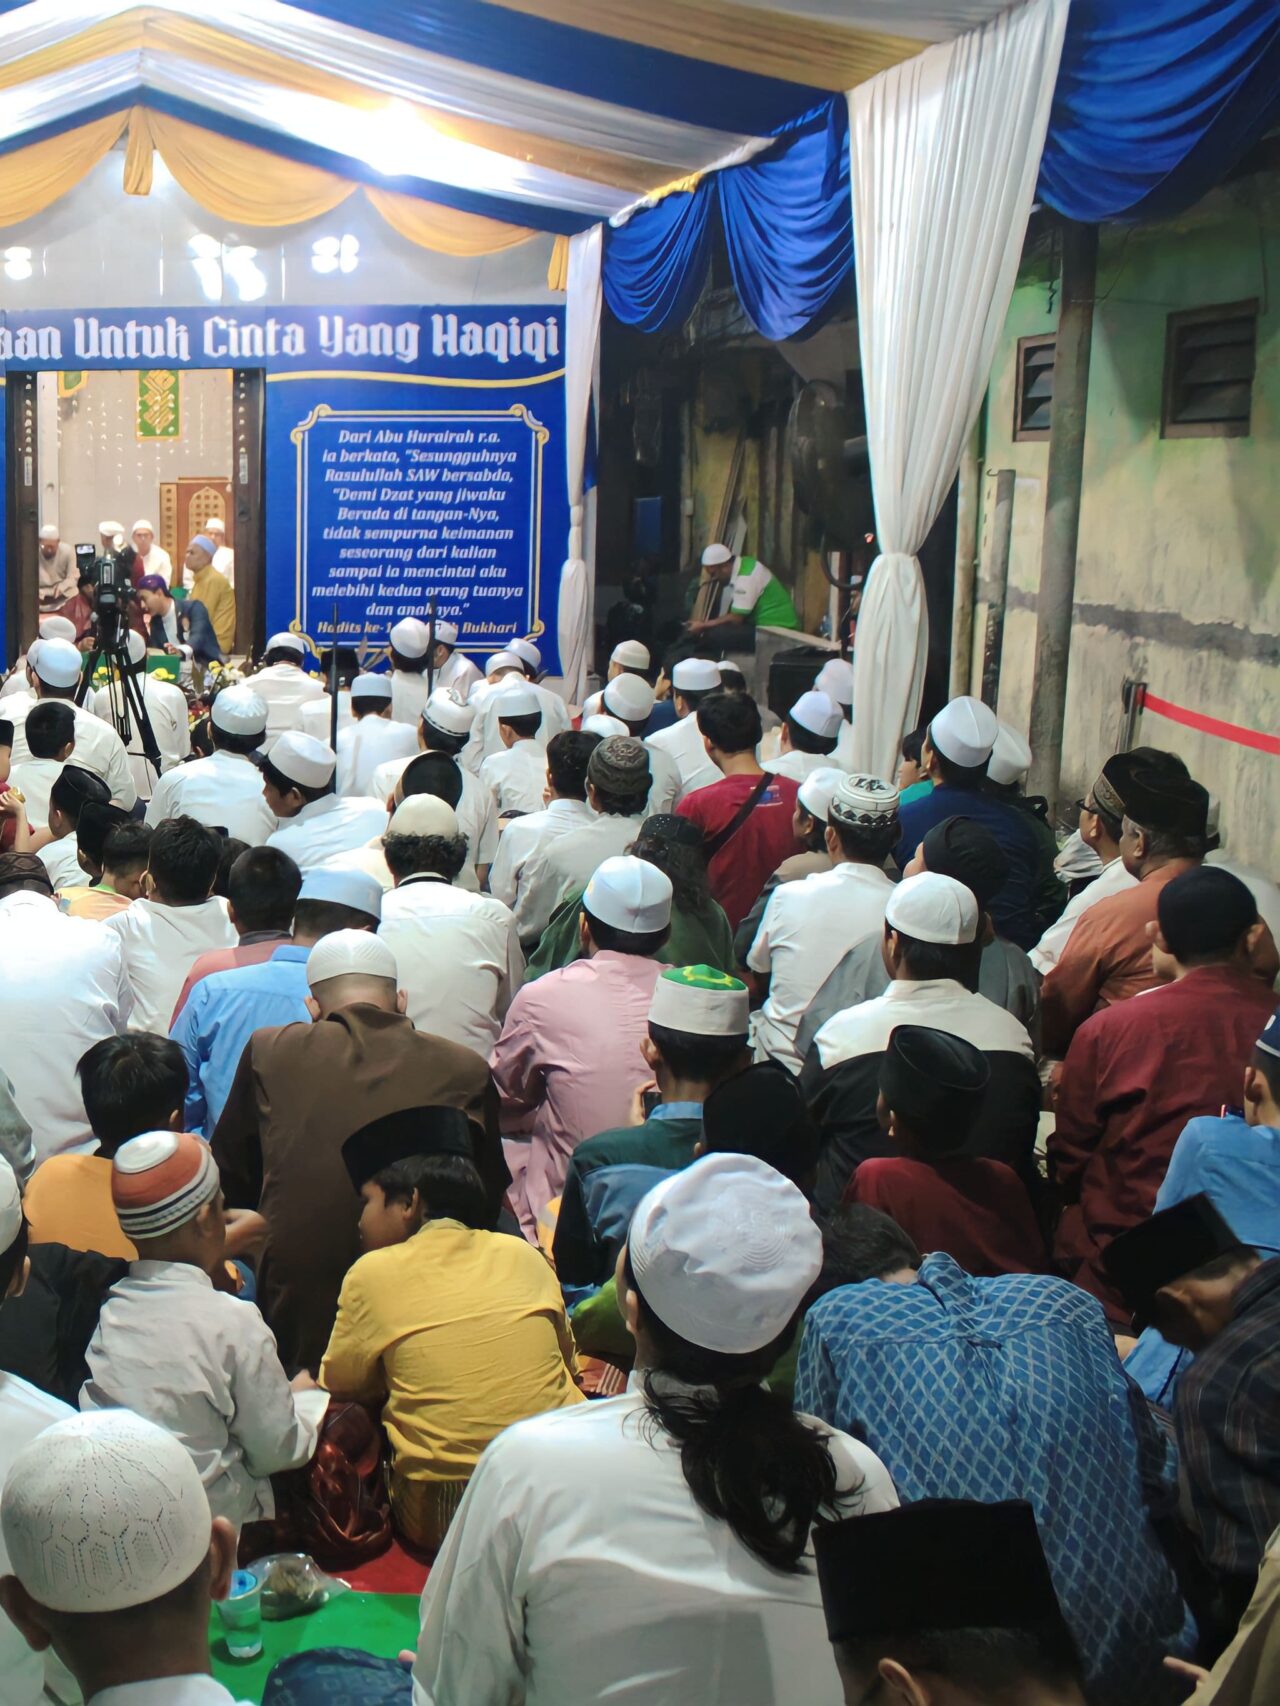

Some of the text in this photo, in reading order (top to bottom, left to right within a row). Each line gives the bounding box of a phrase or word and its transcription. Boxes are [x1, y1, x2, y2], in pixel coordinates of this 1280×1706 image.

[74, 316, 191, 362] Untuk
[203, 315, 306, 357] Cinta
[318, 315, 420, 364] Yang
[431, 313, 560, 364] Haqiqi
[338, 430, 501, 443] Dari Abu Hurairah r.a.
[340, 450, 400, 464] berkata,
[325, 468, 514, 483] Rasulullah SAW bersabda,
[380, 488, 414, 501] Dzat
[415, 491, 452, 504] yang
[455, 488, 506, 504] jiwaku
[337, 507, 500, 523] Berada di tangan-Nya,
[323, 527, 513, 543] tidak sempurna keimanan
[339, 546, 496, 561] seseorang dari kalian
[329, 565, 507, 580] sampai ia mencintai aku
[312, 584, 524, 600] melebihi kedua orang tuanya
[366, 603, 393, 616] dan
[318, 621, 361, 634] Hadits
[461, 621, 517, 634] Bukhari
